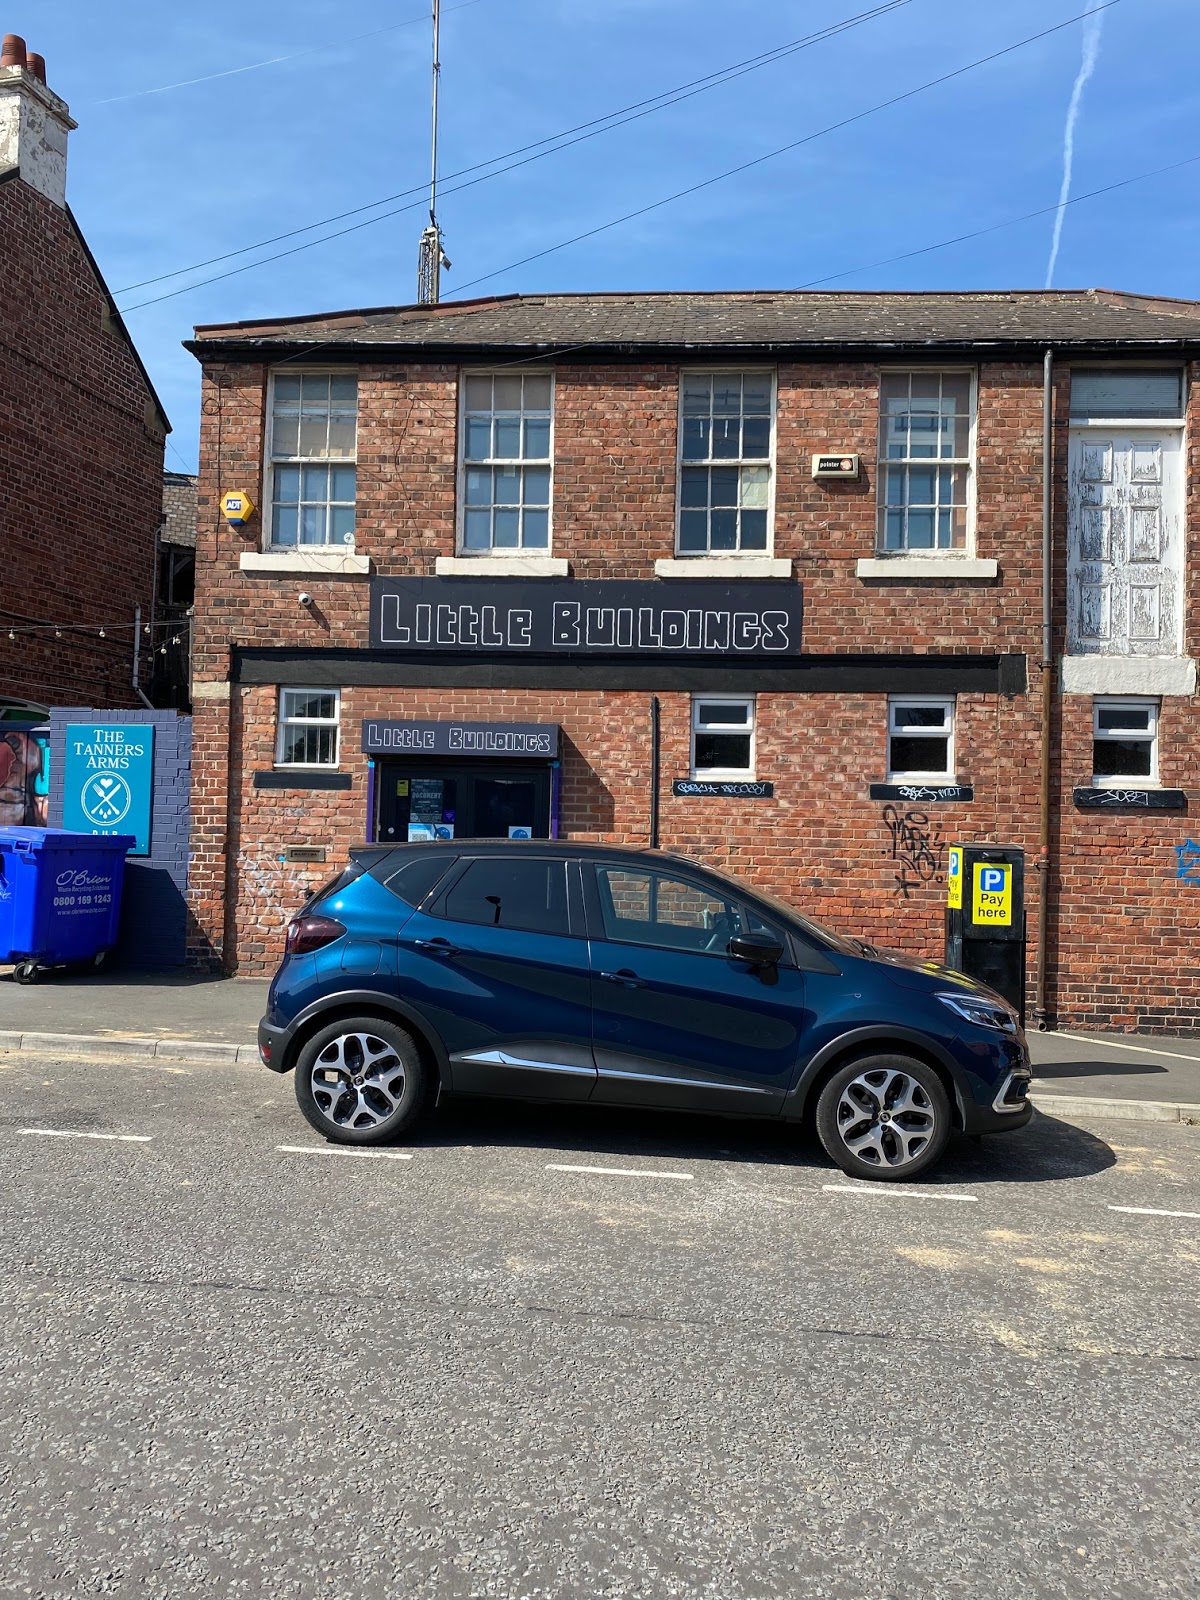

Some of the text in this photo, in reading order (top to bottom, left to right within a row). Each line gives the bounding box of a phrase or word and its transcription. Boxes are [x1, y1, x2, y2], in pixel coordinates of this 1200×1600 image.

[227, 500, 241, 509] ADT
[553, 601, 790, 650] BUILDINGS
[93, 729, 125, 743] THE
[449, 728, 550, 752] BUILDINGS
[74, 742, 144, 756] TANNERS
[86, 755, 130, 769] ARMS
[56, 869, 112, 886] O'Brien
[53, 894, 112, 907] 0800 169 1243
[981, 893, 1005, 907] Pay
[978, 907, 1007, 918] here
